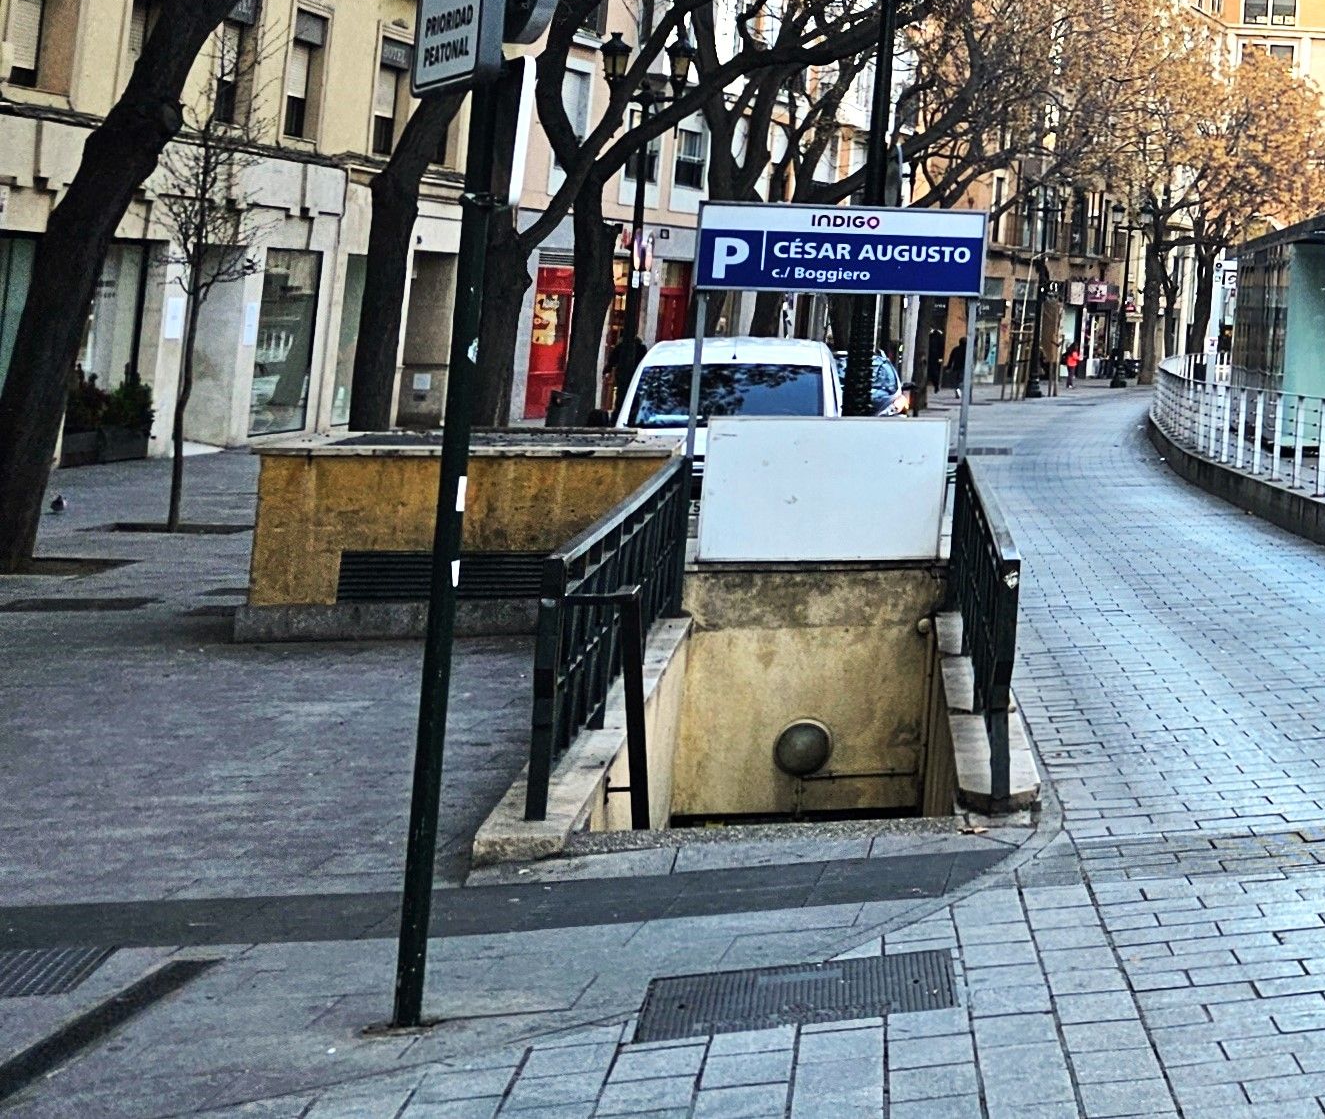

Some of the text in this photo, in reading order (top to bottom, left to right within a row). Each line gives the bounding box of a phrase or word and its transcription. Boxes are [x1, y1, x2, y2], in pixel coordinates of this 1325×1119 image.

[425, 4, 474, 37] PRIORIDAD
[423, 37, 470, 68] PEATONAL
[811, 214, 880, 230] INDIGO
[711, 237, 750, 279] P
[773, 238, 971, 264] CÉSAR AUGUSTO
[794, 266, 871, 282] Boggiero
